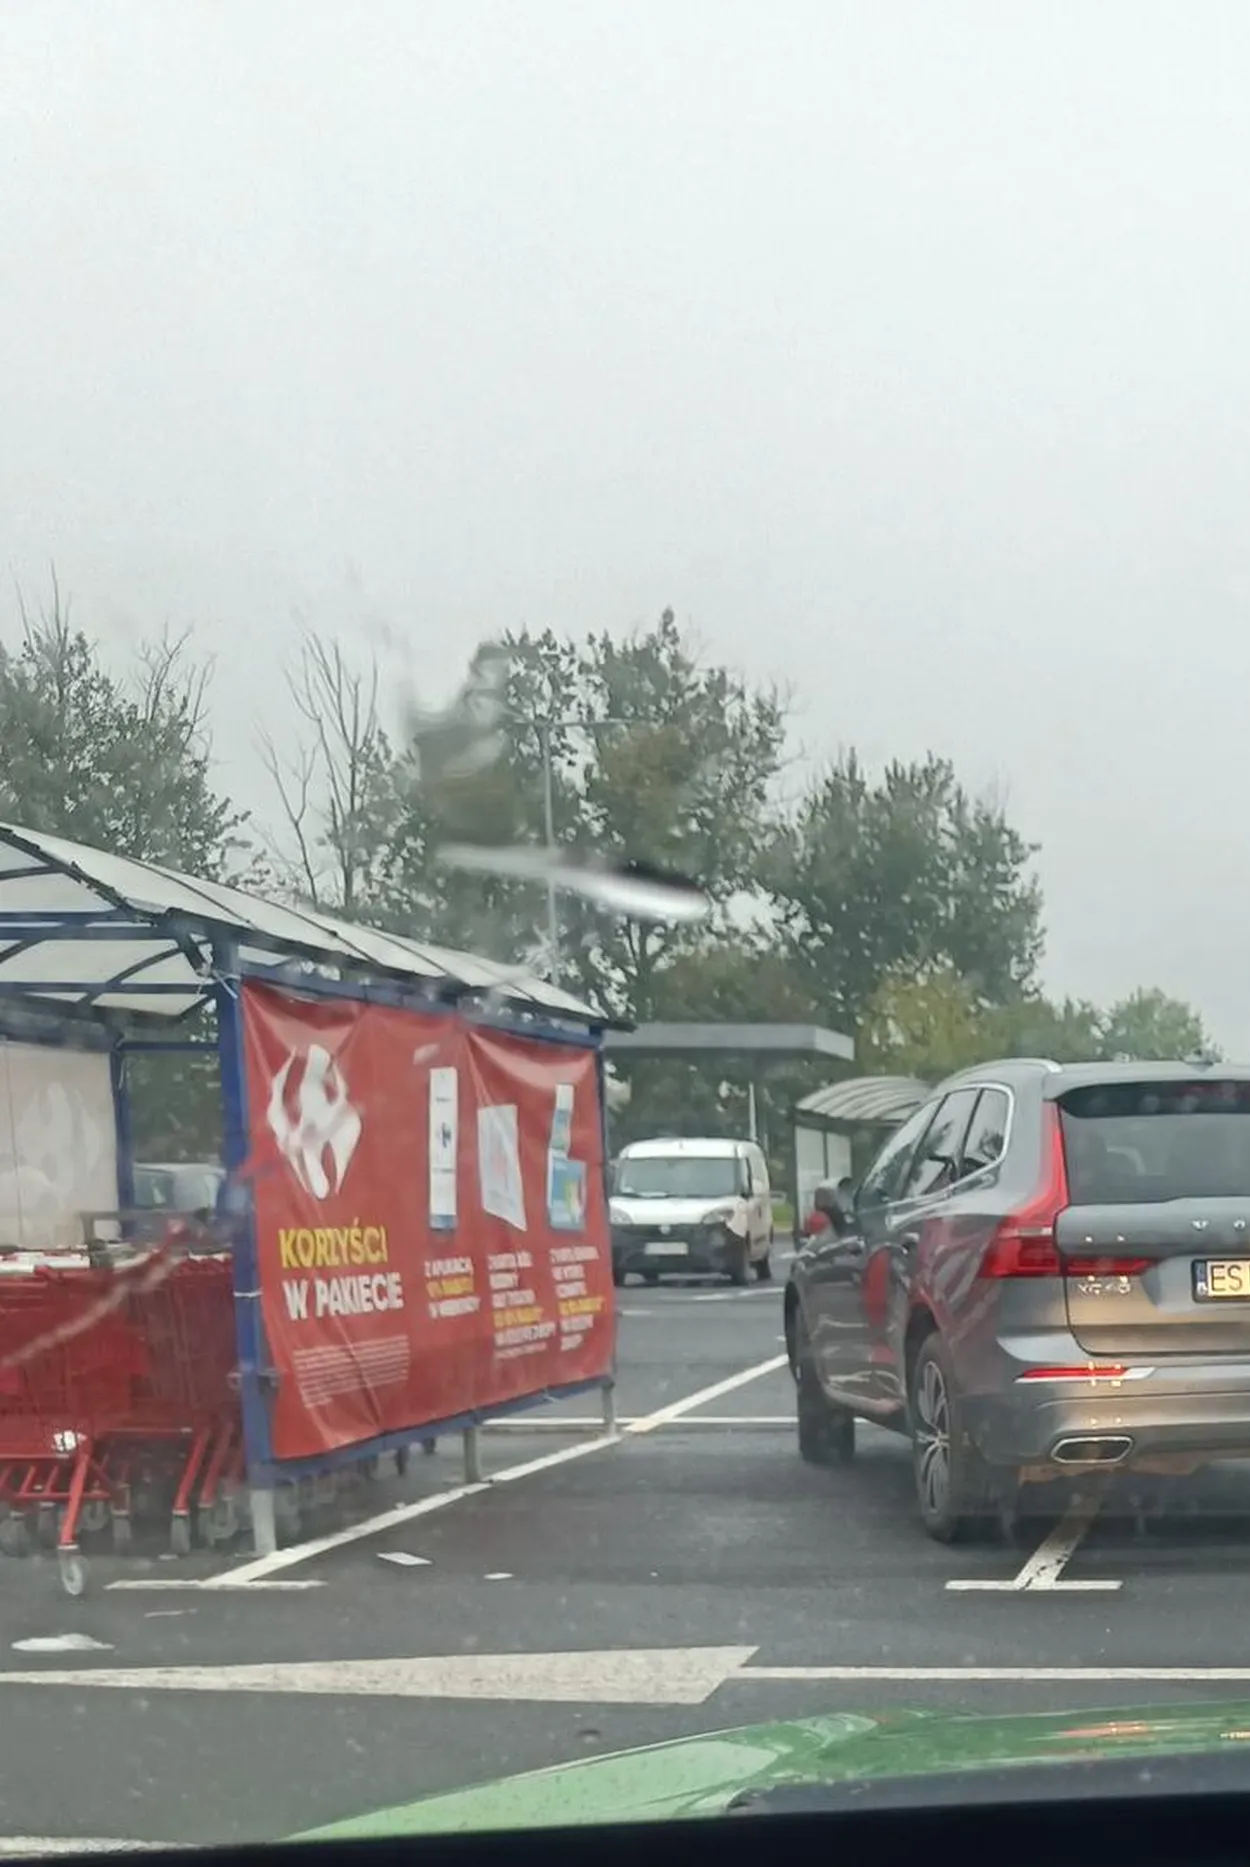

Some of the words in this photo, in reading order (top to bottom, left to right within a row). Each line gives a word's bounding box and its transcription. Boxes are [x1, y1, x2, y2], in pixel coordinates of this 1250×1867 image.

[278, 1216, 389, 1269] KORZYŚCI
[282, 1278, 309, 1321] W
[315, 1271, 405, 1318] PAKIECIE
